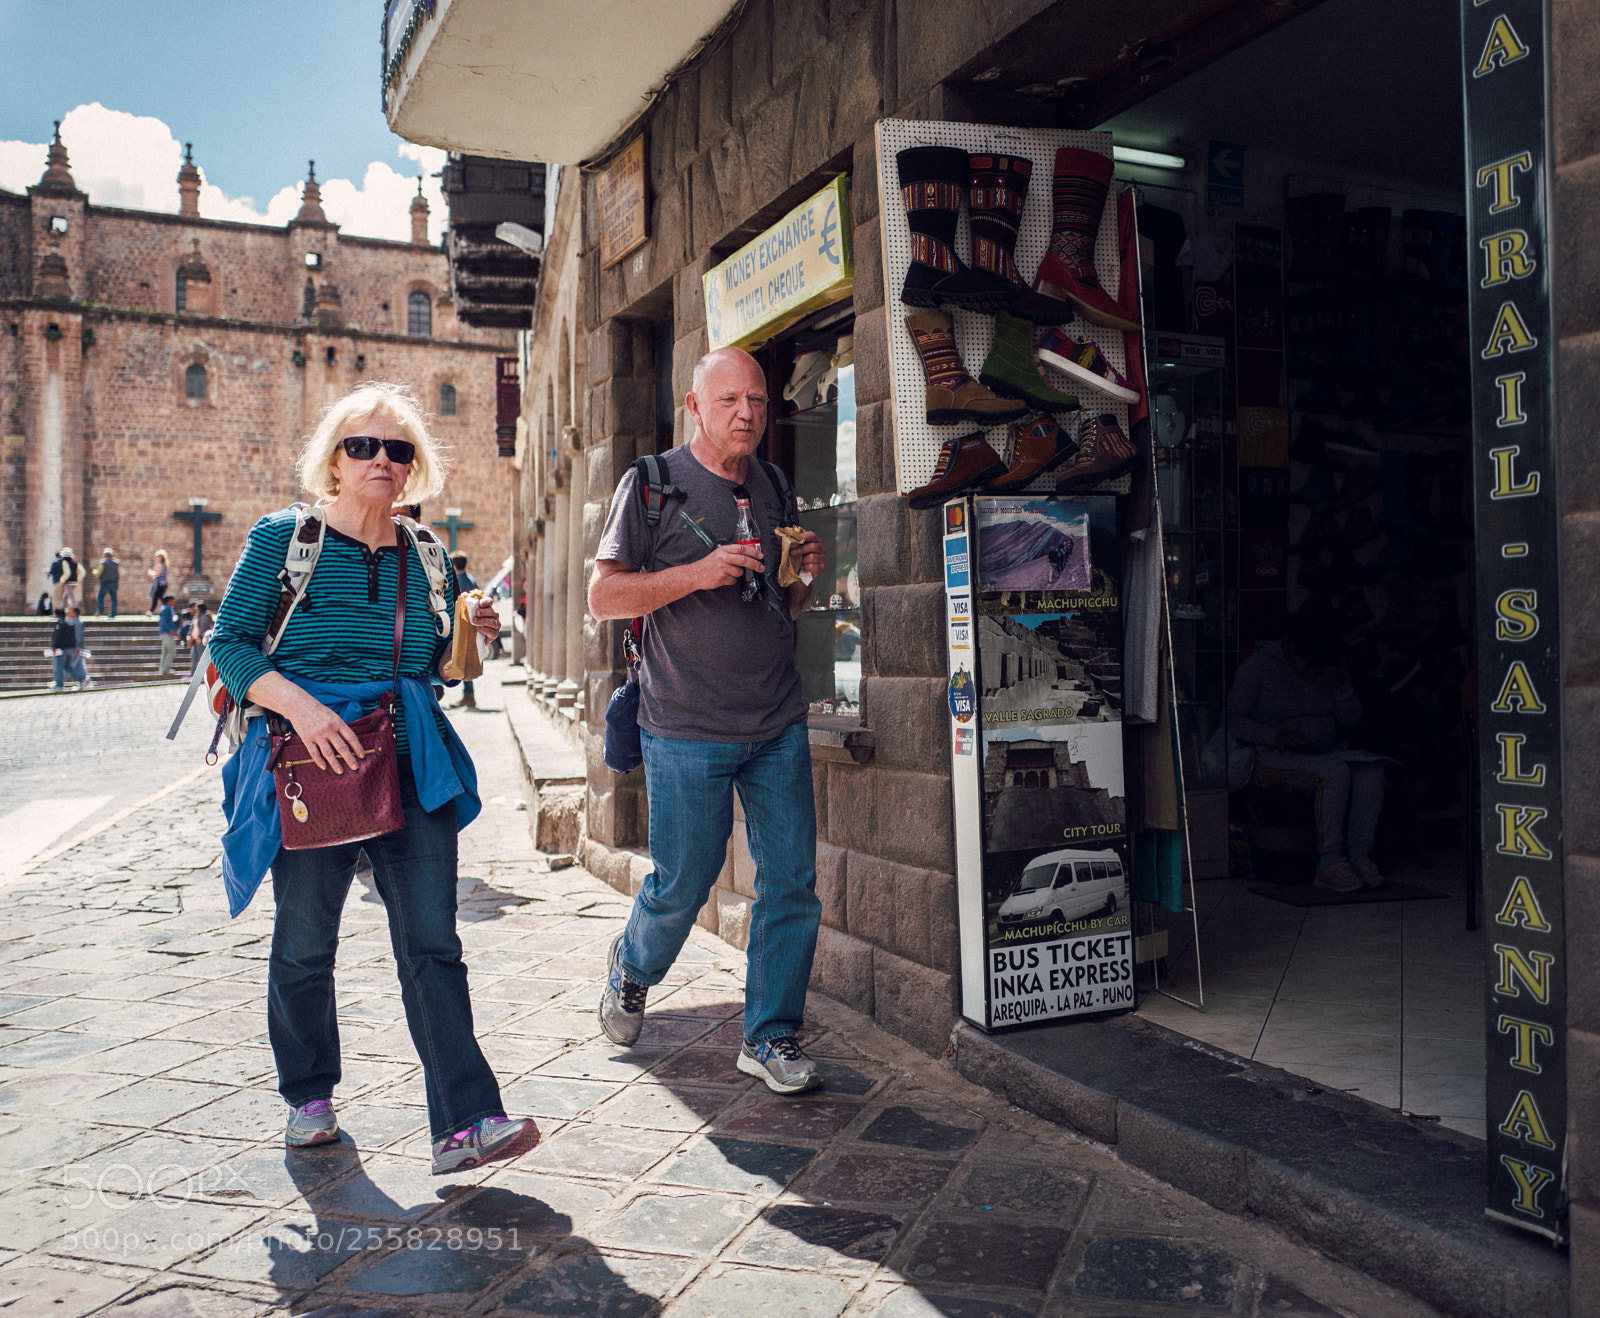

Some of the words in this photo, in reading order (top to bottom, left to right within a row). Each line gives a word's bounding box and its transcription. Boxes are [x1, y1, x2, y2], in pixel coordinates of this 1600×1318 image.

[725, 249, 756, 293] MONEY
[760, 208, 815, 270] EXCHANGE
[735, 286, 766, 326] TRAVEL
[768, 261, 805, 306] CHEQUE
[953, 602, 969, 614] VISA
[1037, 597, 1118, 609] MACHUPICCHU
[955, 629, 969, 641] VISA
[954, 700, 971, 711] VISA
[984, 709, 1018, 722] VALLE
[1020, 706, 1074, 720] SAGRADO
[1063, 826, 1088, 838] CITY
[1090, 823, 1121, 835] TOUR
[1004, 920, 1087, 941] MACHUPICCHU
[1090, 918, 1103, 929] BY
[1106, 915, 1128, 927] CAR
[993, 947, 1040, 973] BUS
[1046, 935, 1130, 965] TICKET
[993, 972, 1044, 1000] INKA
[1049, 958, 1131, 991] EXPRESS
[993, 997, 1048, 1022] AREQUIPA
[1057, 993, 1071, 1011] LA
[1073, 990, 1093, 1009] PAZ
[1102, 984, 1133, 1005] PUNO
